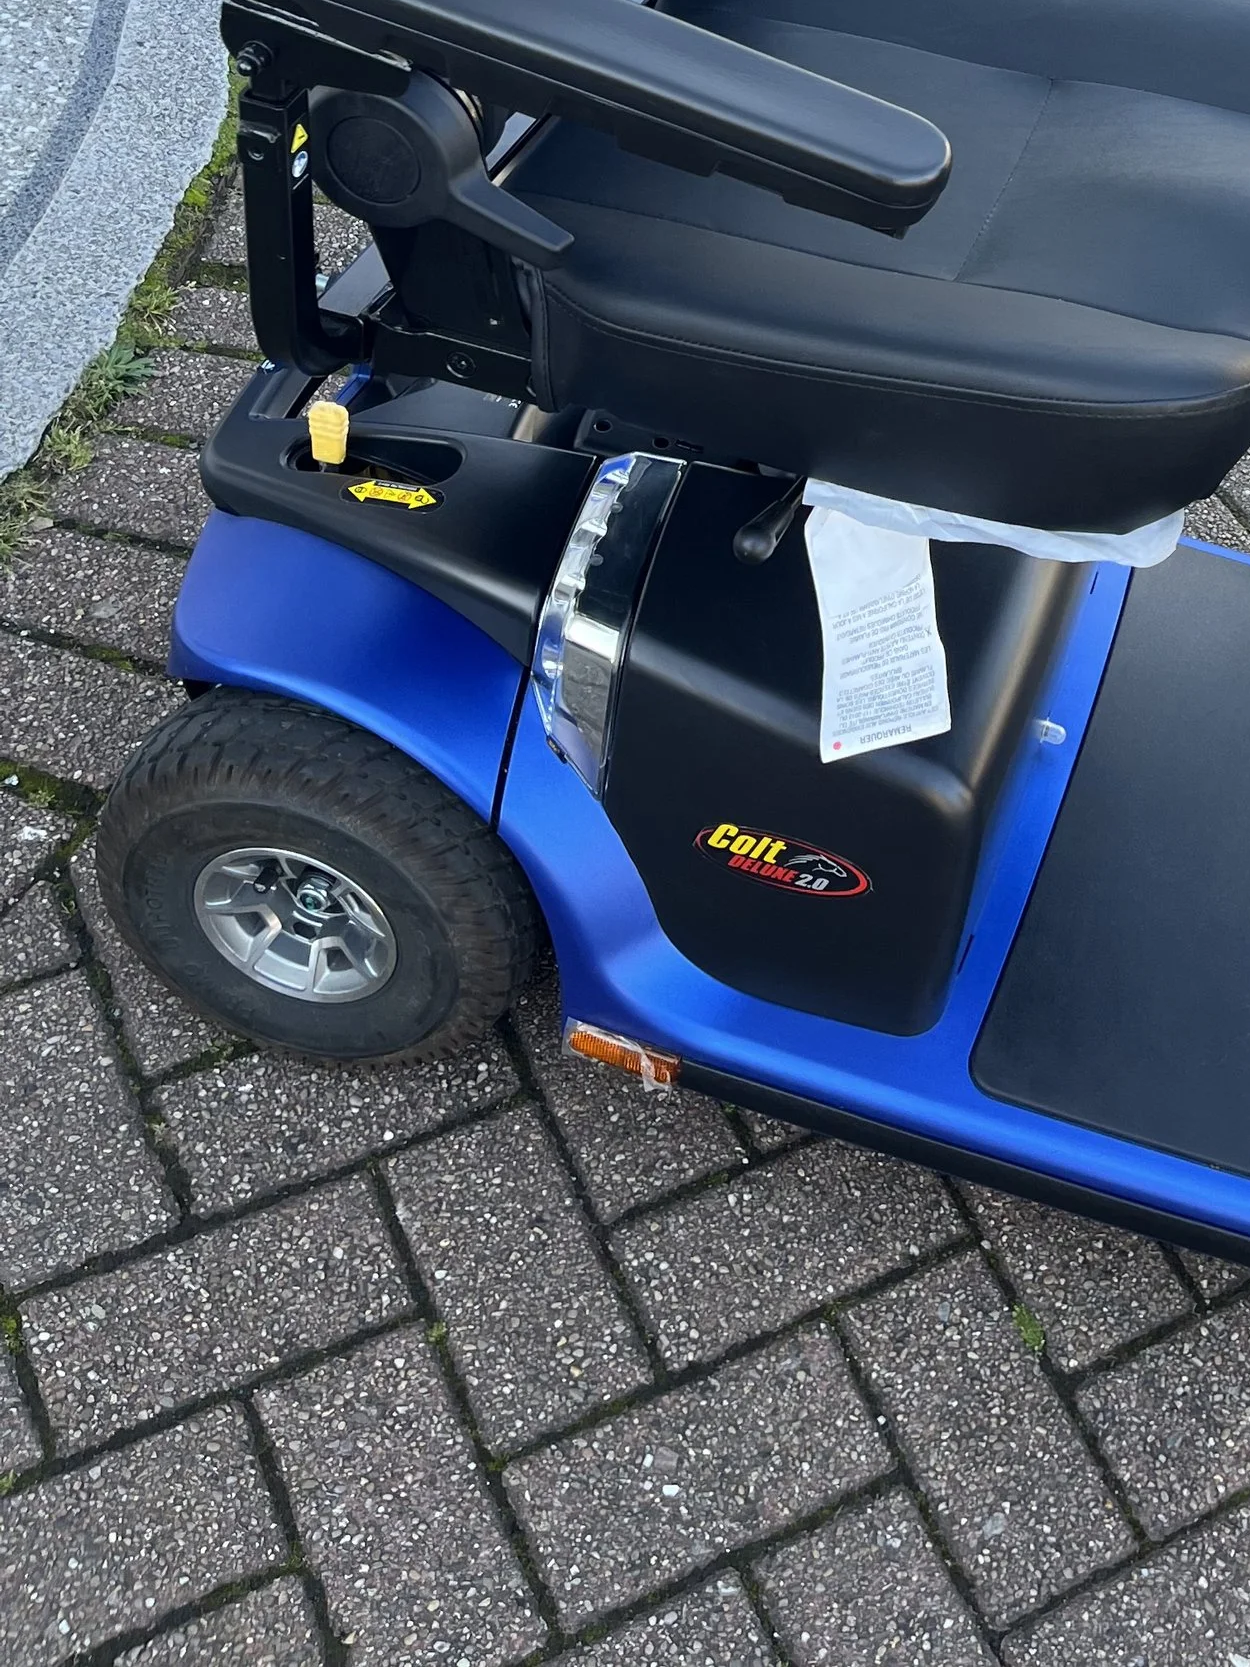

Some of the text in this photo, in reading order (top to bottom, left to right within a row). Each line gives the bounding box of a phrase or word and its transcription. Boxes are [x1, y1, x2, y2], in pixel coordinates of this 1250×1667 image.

[859, 723, 911, 744] REMARQUER
[707, 823, 787, 864] Colt
[728, 855, 829, 891] DELUXE 2.0
